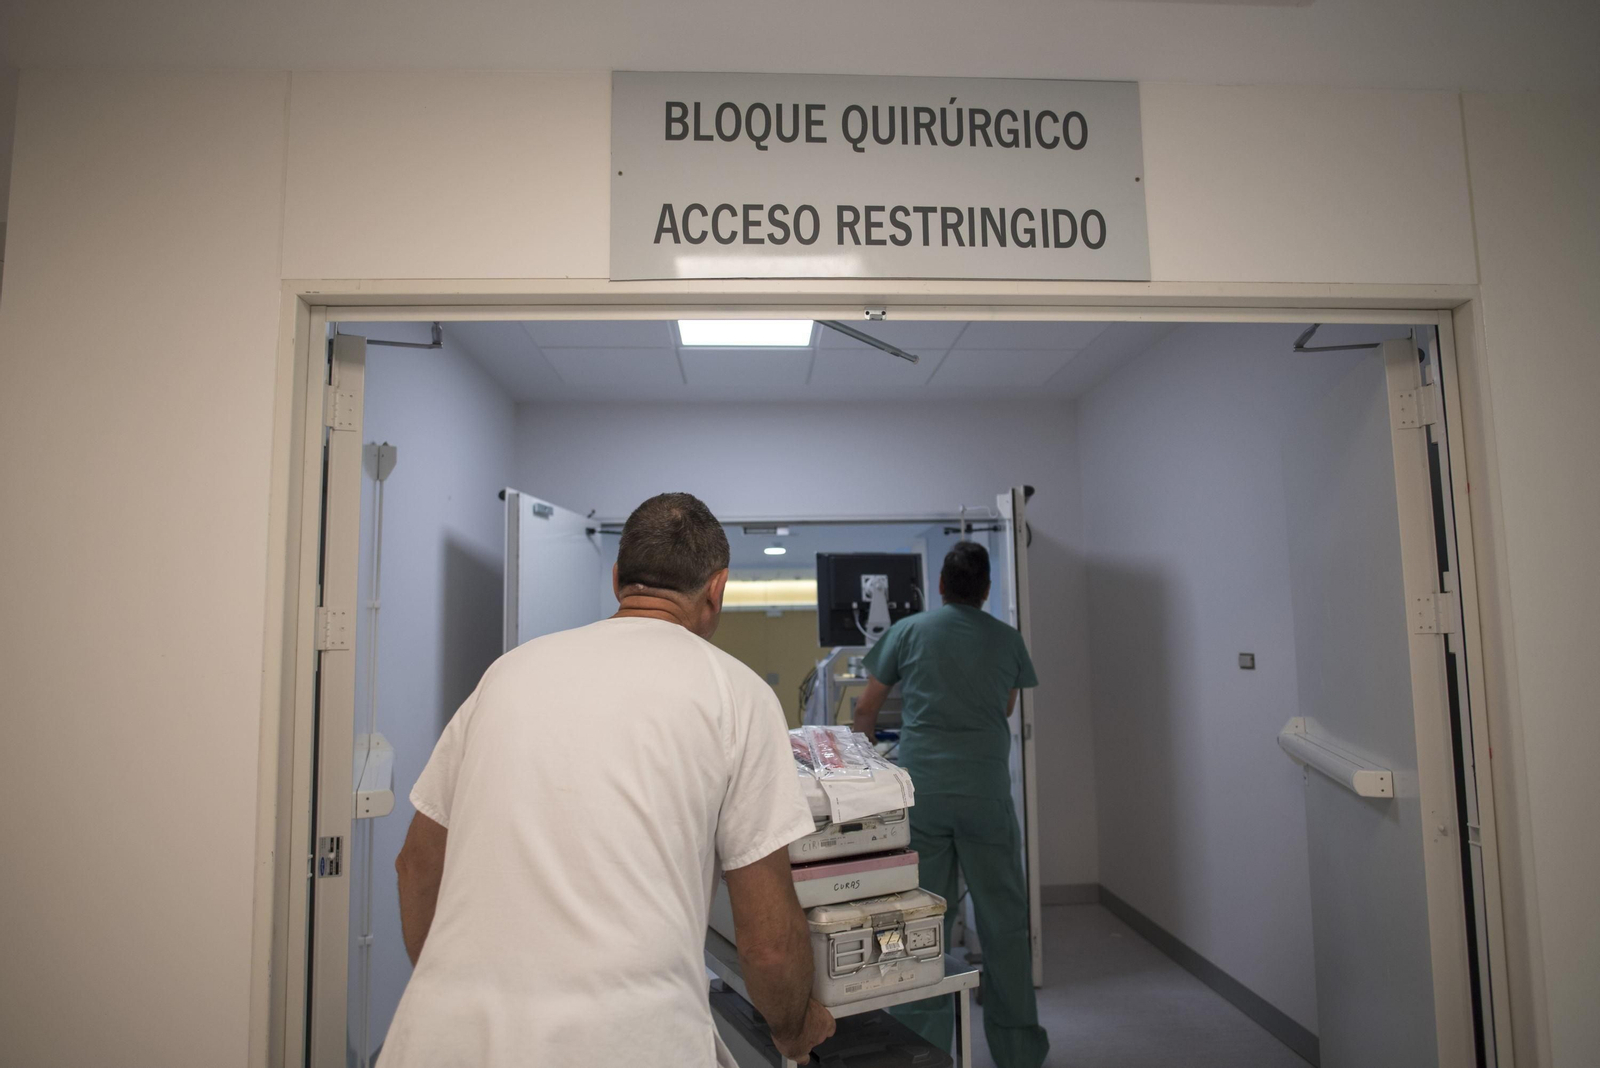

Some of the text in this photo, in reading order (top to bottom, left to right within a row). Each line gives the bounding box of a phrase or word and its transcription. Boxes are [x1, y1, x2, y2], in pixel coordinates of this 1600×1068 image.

[664, 96, 1089, 153] BLOQUE QUIRÚRGICO
[653, 203, 1107, 250] ACCESO RESTRINGIDO
[833, 880, 861, 892] CURAS
